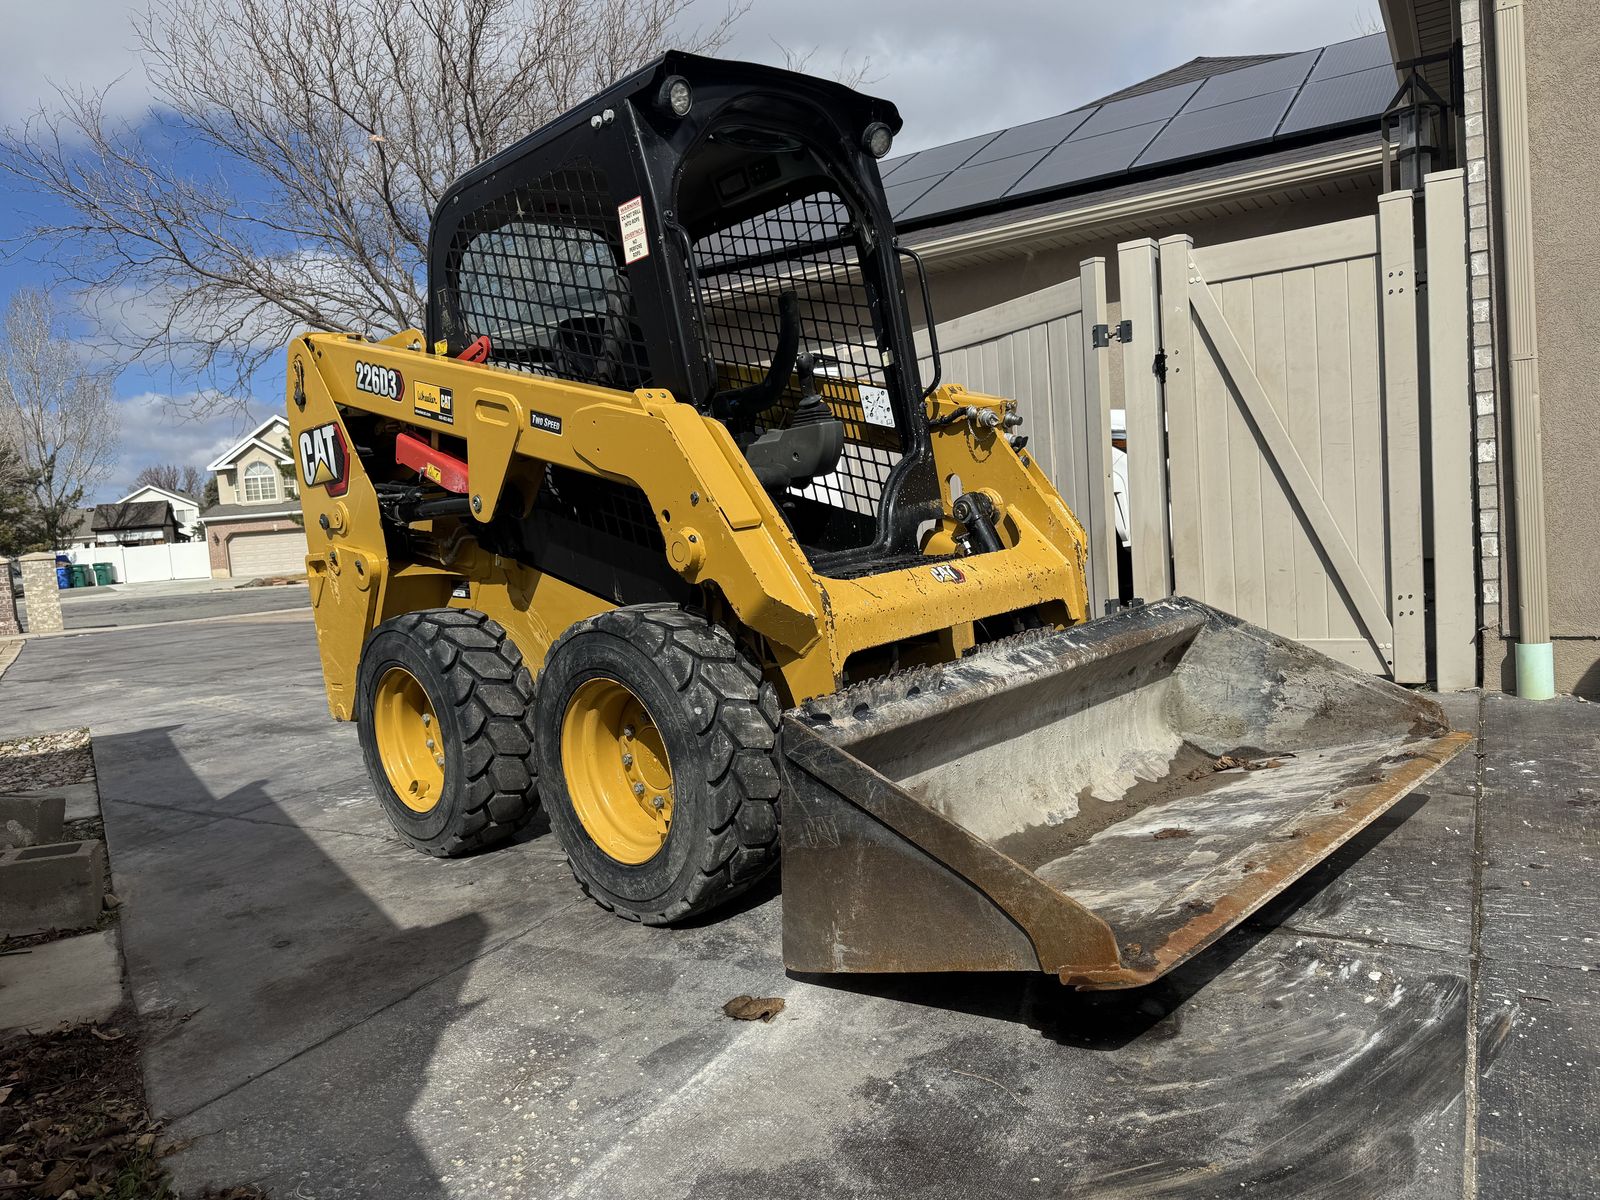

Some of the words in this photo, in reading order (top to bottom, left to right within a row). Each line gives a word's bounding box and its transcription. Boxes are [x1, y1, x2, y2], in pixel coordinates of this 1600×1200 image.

[620, 200, 640, 213] WARNING
[356, 361, 397, 399] 226D3
[440, 394, 451, 410] CAT
[299, 424, 338, 486] CAT
[930, 565, 959, 582] CAT
